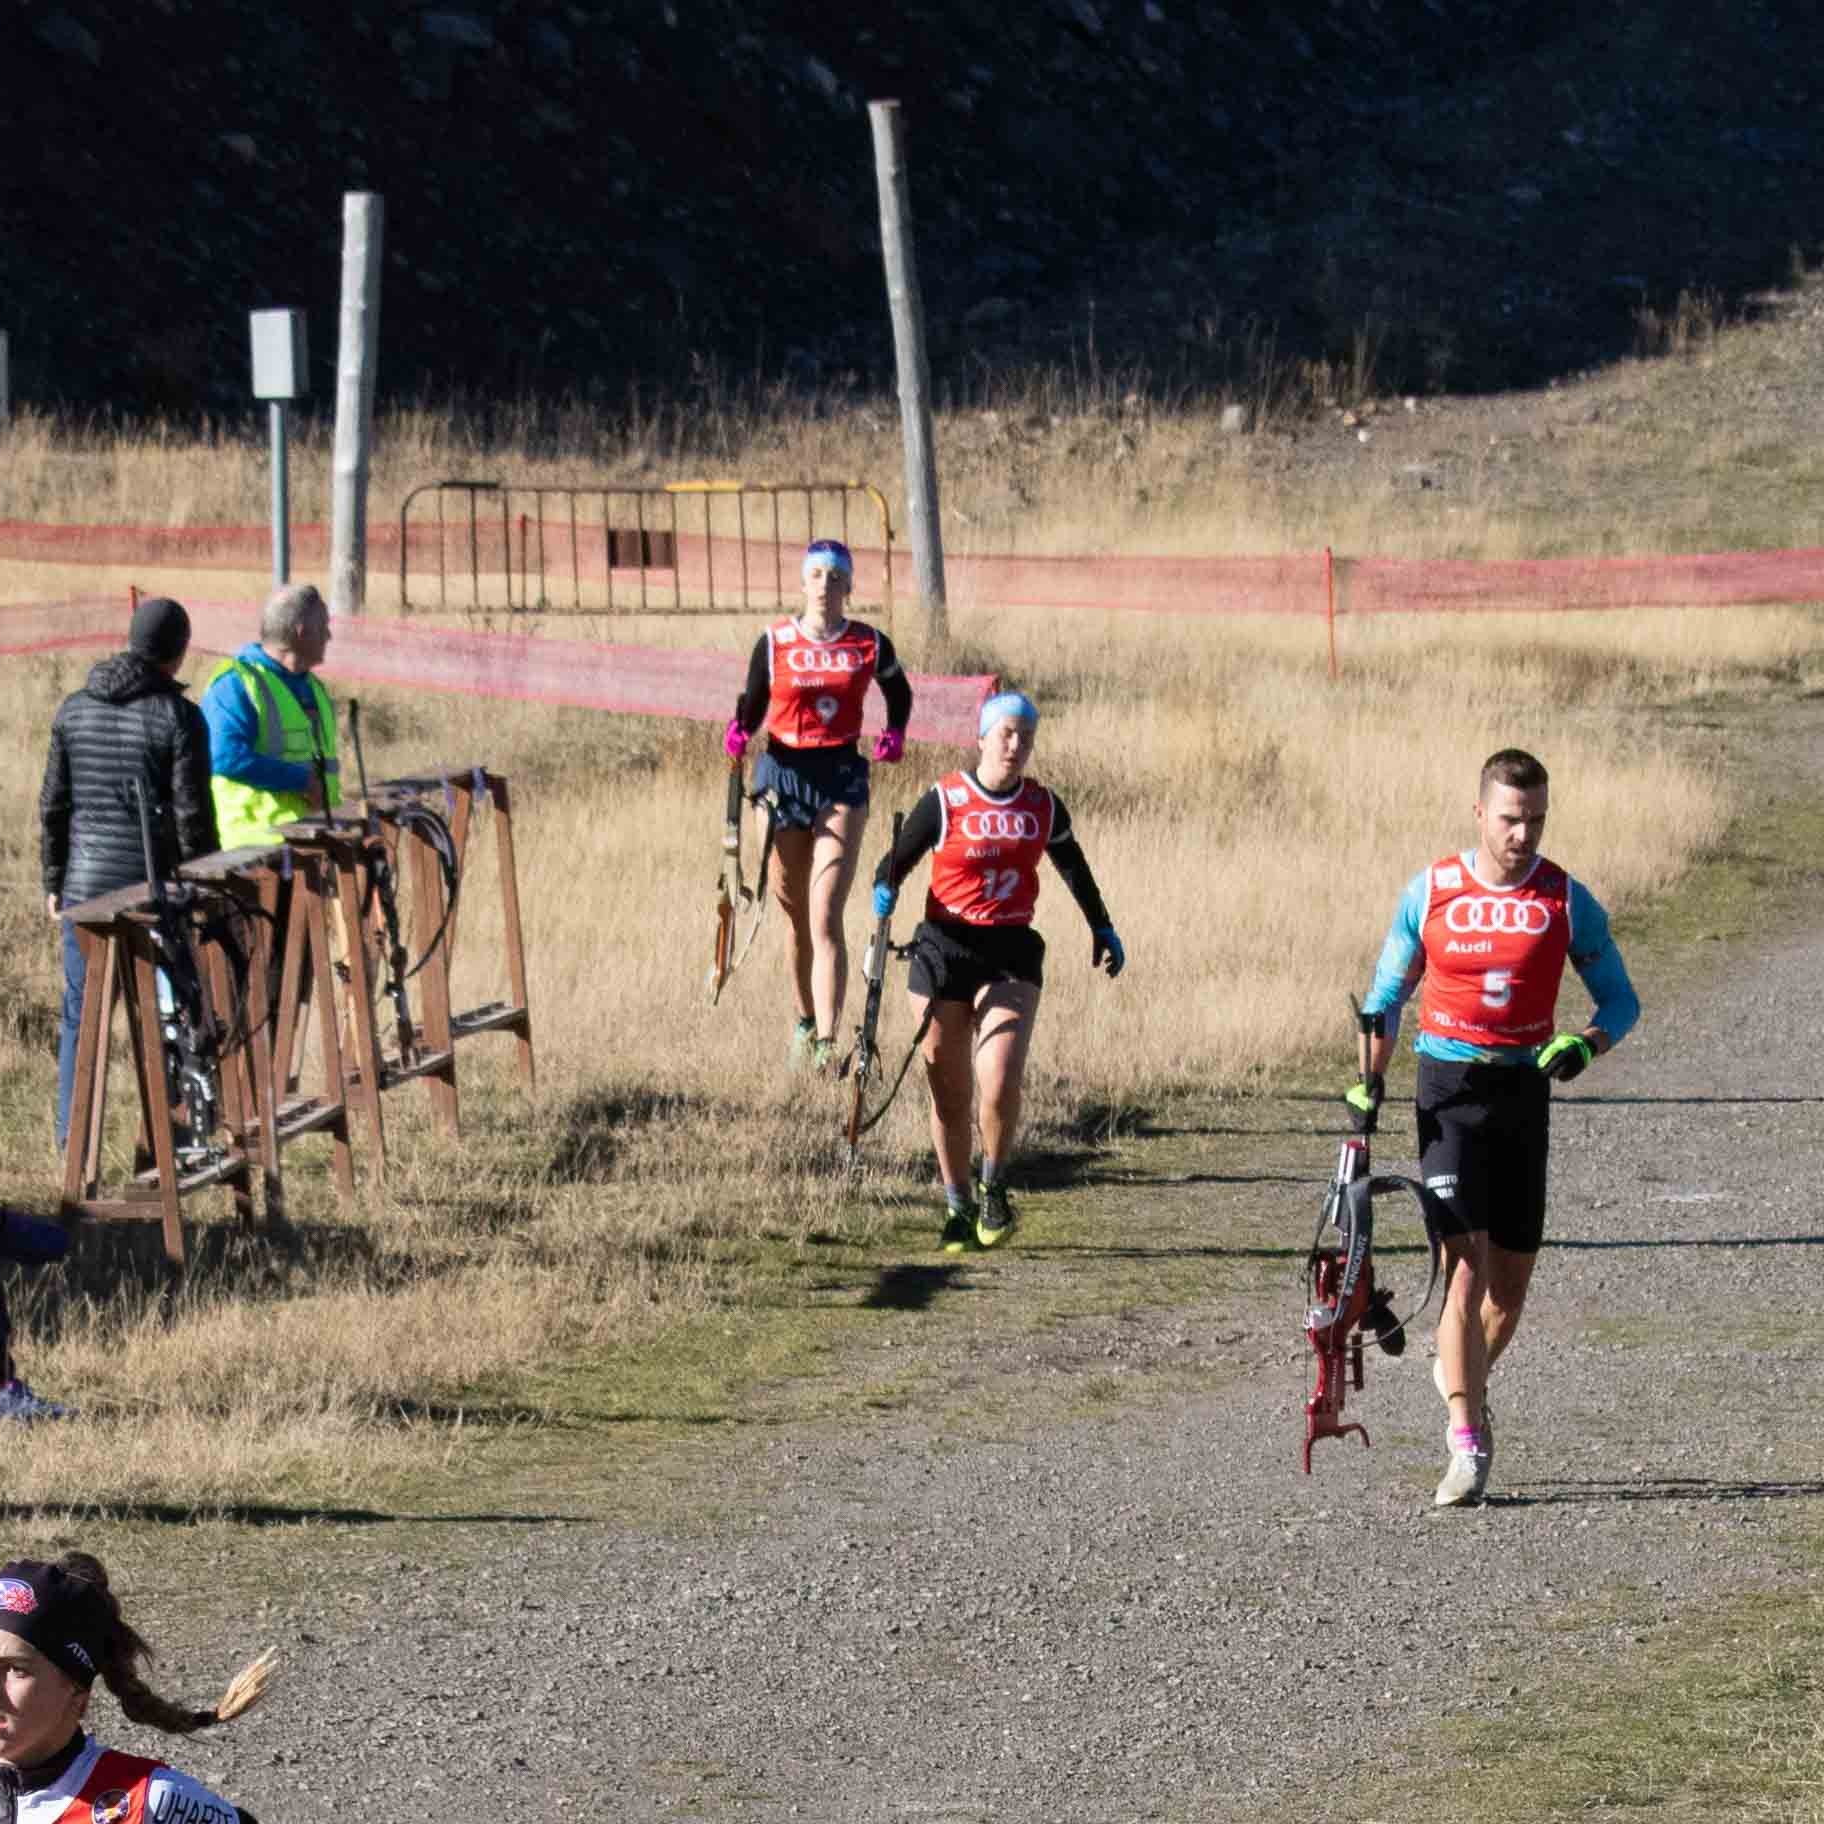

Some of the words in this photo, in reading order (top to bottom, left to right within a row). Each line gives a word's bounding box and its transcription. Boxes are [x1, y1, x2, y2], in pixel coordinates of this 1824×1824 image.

[983, 869, 1020, 899] 12
[1445, 940, 1493, 953] Audi
[1481, 970, 1512, 1008] 5
